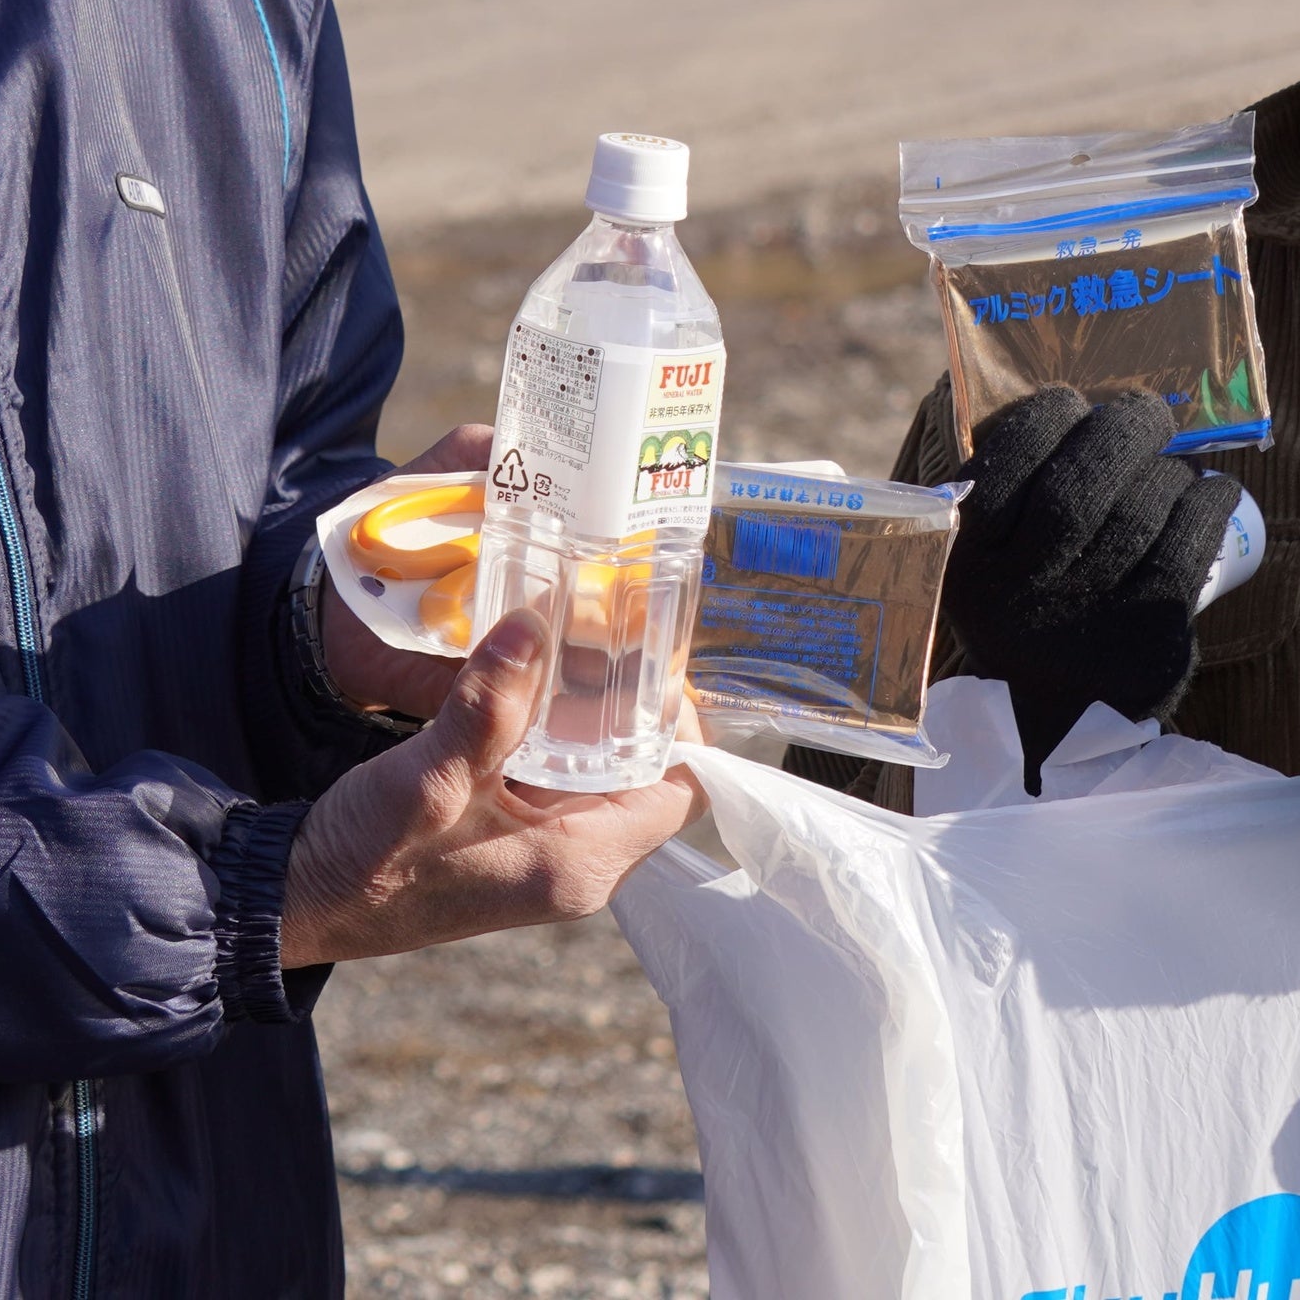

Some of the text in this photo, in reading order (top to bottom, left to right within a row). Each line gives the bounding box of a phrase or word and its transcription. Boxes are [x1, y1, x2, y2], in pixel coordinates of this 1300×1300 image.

[1056, 228, 1142, 261] 救急一発
[969, 255, 1241, 326] アルミック救急シート
[659, 362, 712, 389] FUJI
[649, 403, 713, 419] 非常用5年保存水
[651, 470, 693, 491] FUJI
[496, 490, 519, 504] PET
[730, 482, 844, 508] 白十字株式会社
